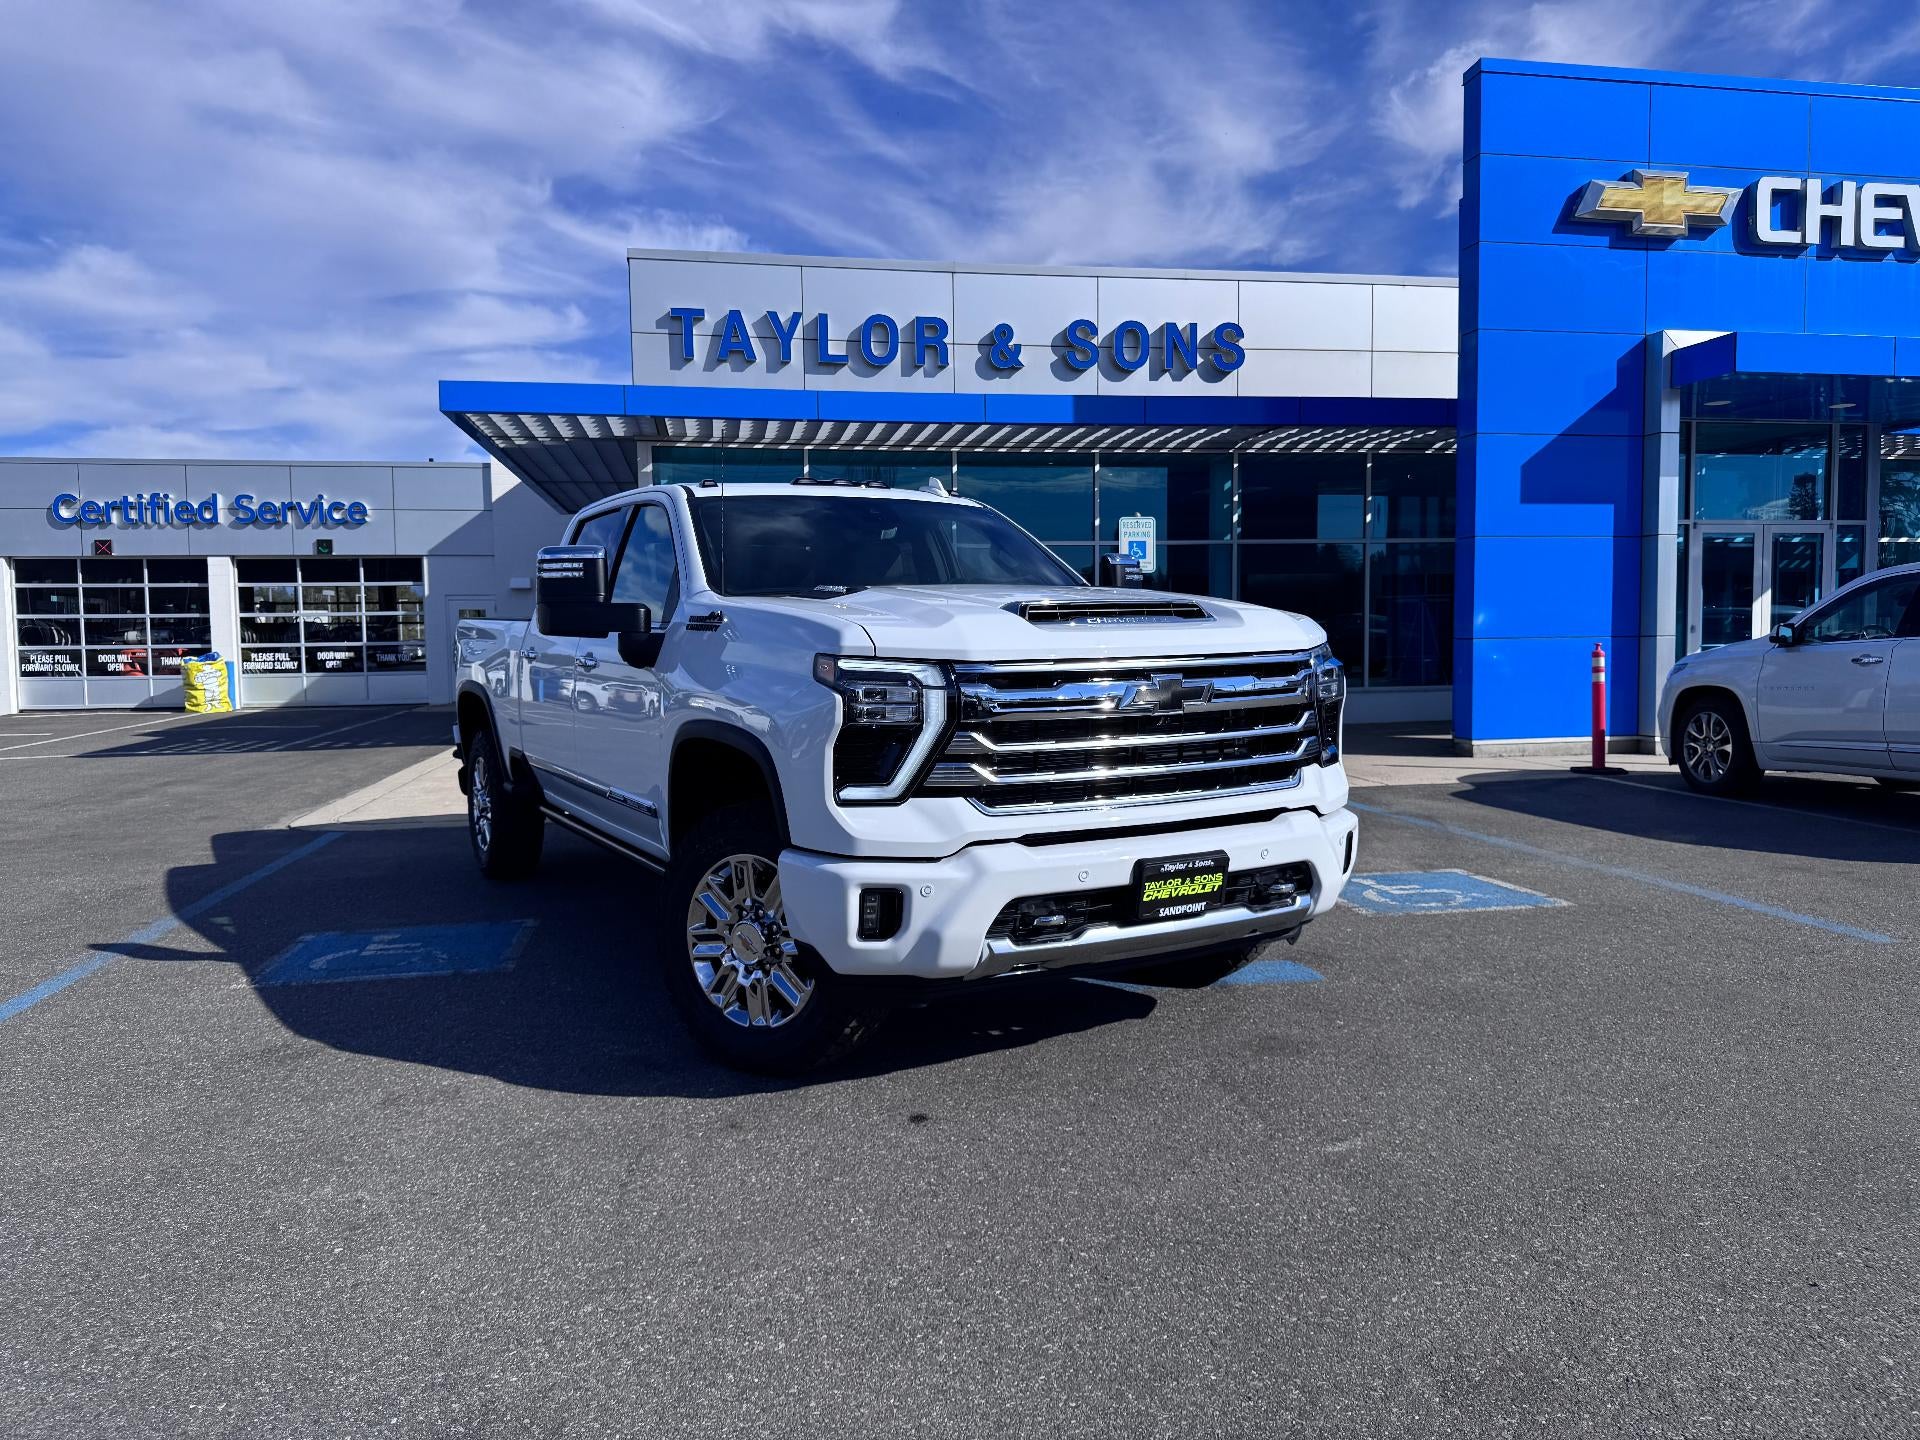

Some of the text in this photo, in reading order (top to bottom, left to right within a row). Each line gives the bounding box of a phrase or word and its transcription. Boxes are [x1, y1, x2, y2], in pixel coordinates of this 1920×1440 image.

[669, 306, 1247, 372] TAYLOR & SONS
[52, 493, 369, 524] Certified Service
[1122, 521, 1152, 529] RESERVED
[30, 655, 71, 663] PLEASE PULL
[98, 654, 116, 663] DOOR
[117, 654, 132, 663] WILL
[251, 652, 290, 661] PLEASE PULL
[317, 651, 335, 660] DOOR
[376, 653, 397, 662] THANK
[21, 663, 80, 672] FORWARD SLOWLY
[107, 662, 125, 671] OPEN
[243, 661, 298, 670] FORWARD SLOWLY
[1163, 863, 1188, 873] Taylor
[1194, 859, 1211, 868] Sons
[1144, 872, 1223, 891] TAYLOR & SONS
[1142, 882, 1223, 902] CHEVROLET
[1158, 901, 1207, 917] SANDPOINT
